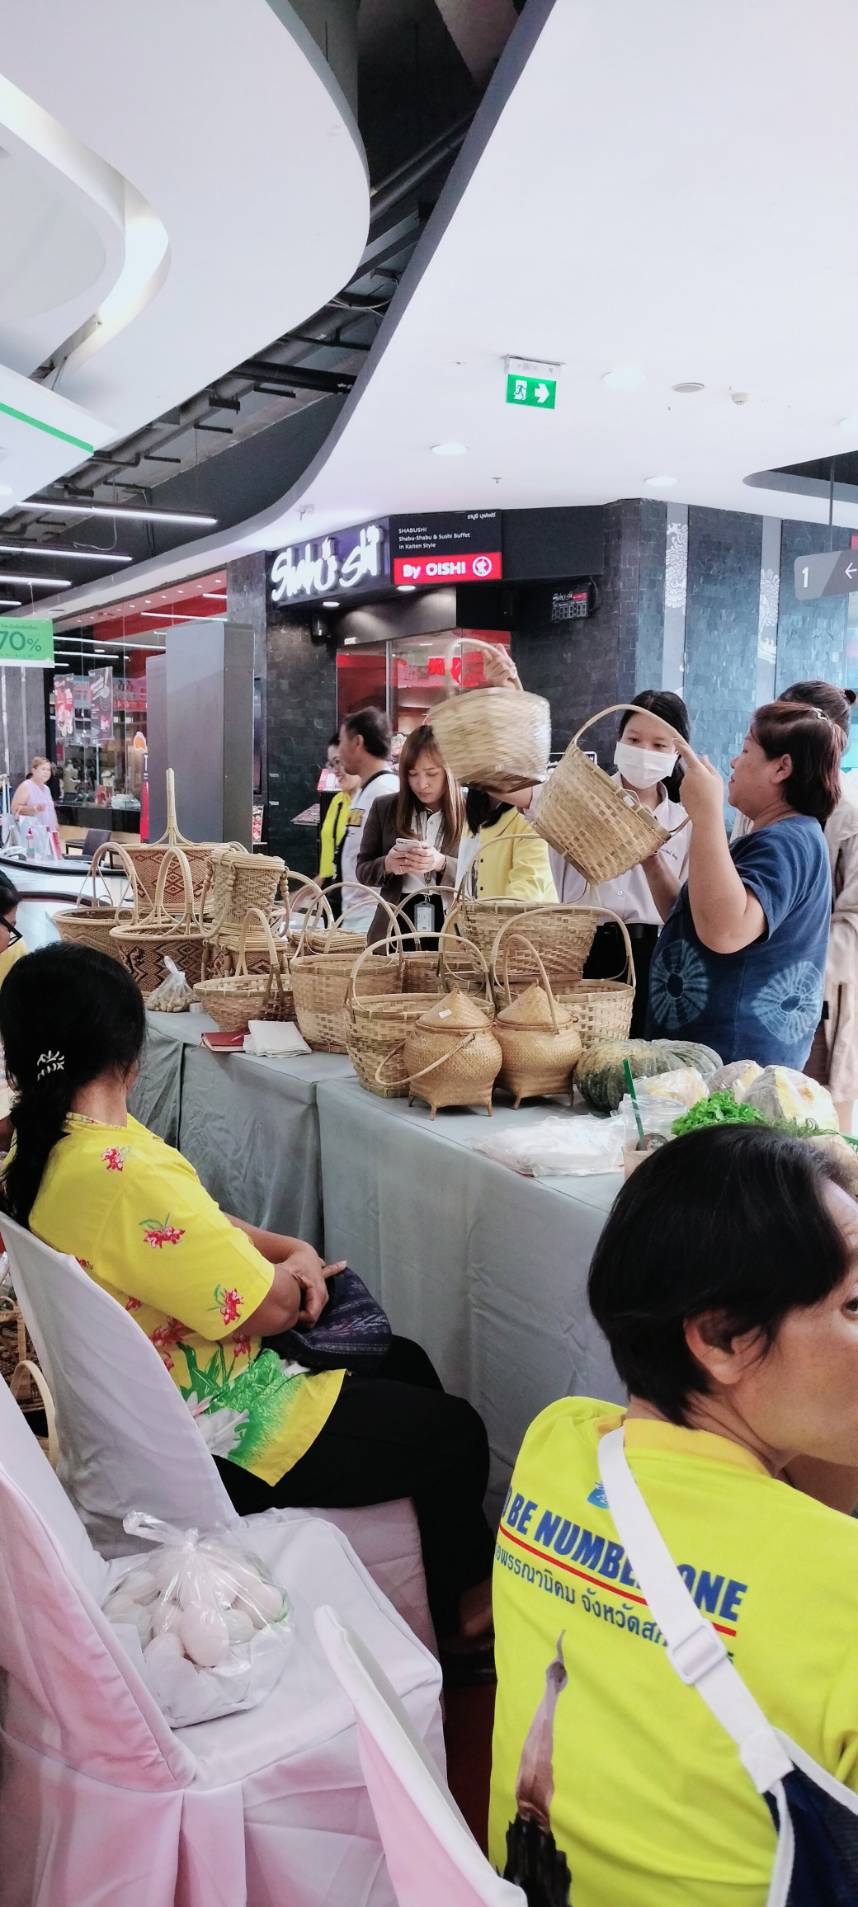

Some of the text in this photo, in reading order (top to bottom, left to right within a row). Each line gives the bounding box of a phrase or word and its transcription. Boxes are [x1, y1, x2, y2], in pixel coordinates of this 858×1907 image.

[402, 561, 466, 579] By OISHI
[802, 566, 809, 588] 1
[506, 1492, 539, 1536] BE
[533, 1509, 643, 1590] NUMBE
[675, 1563, 748, 1622] ONE
